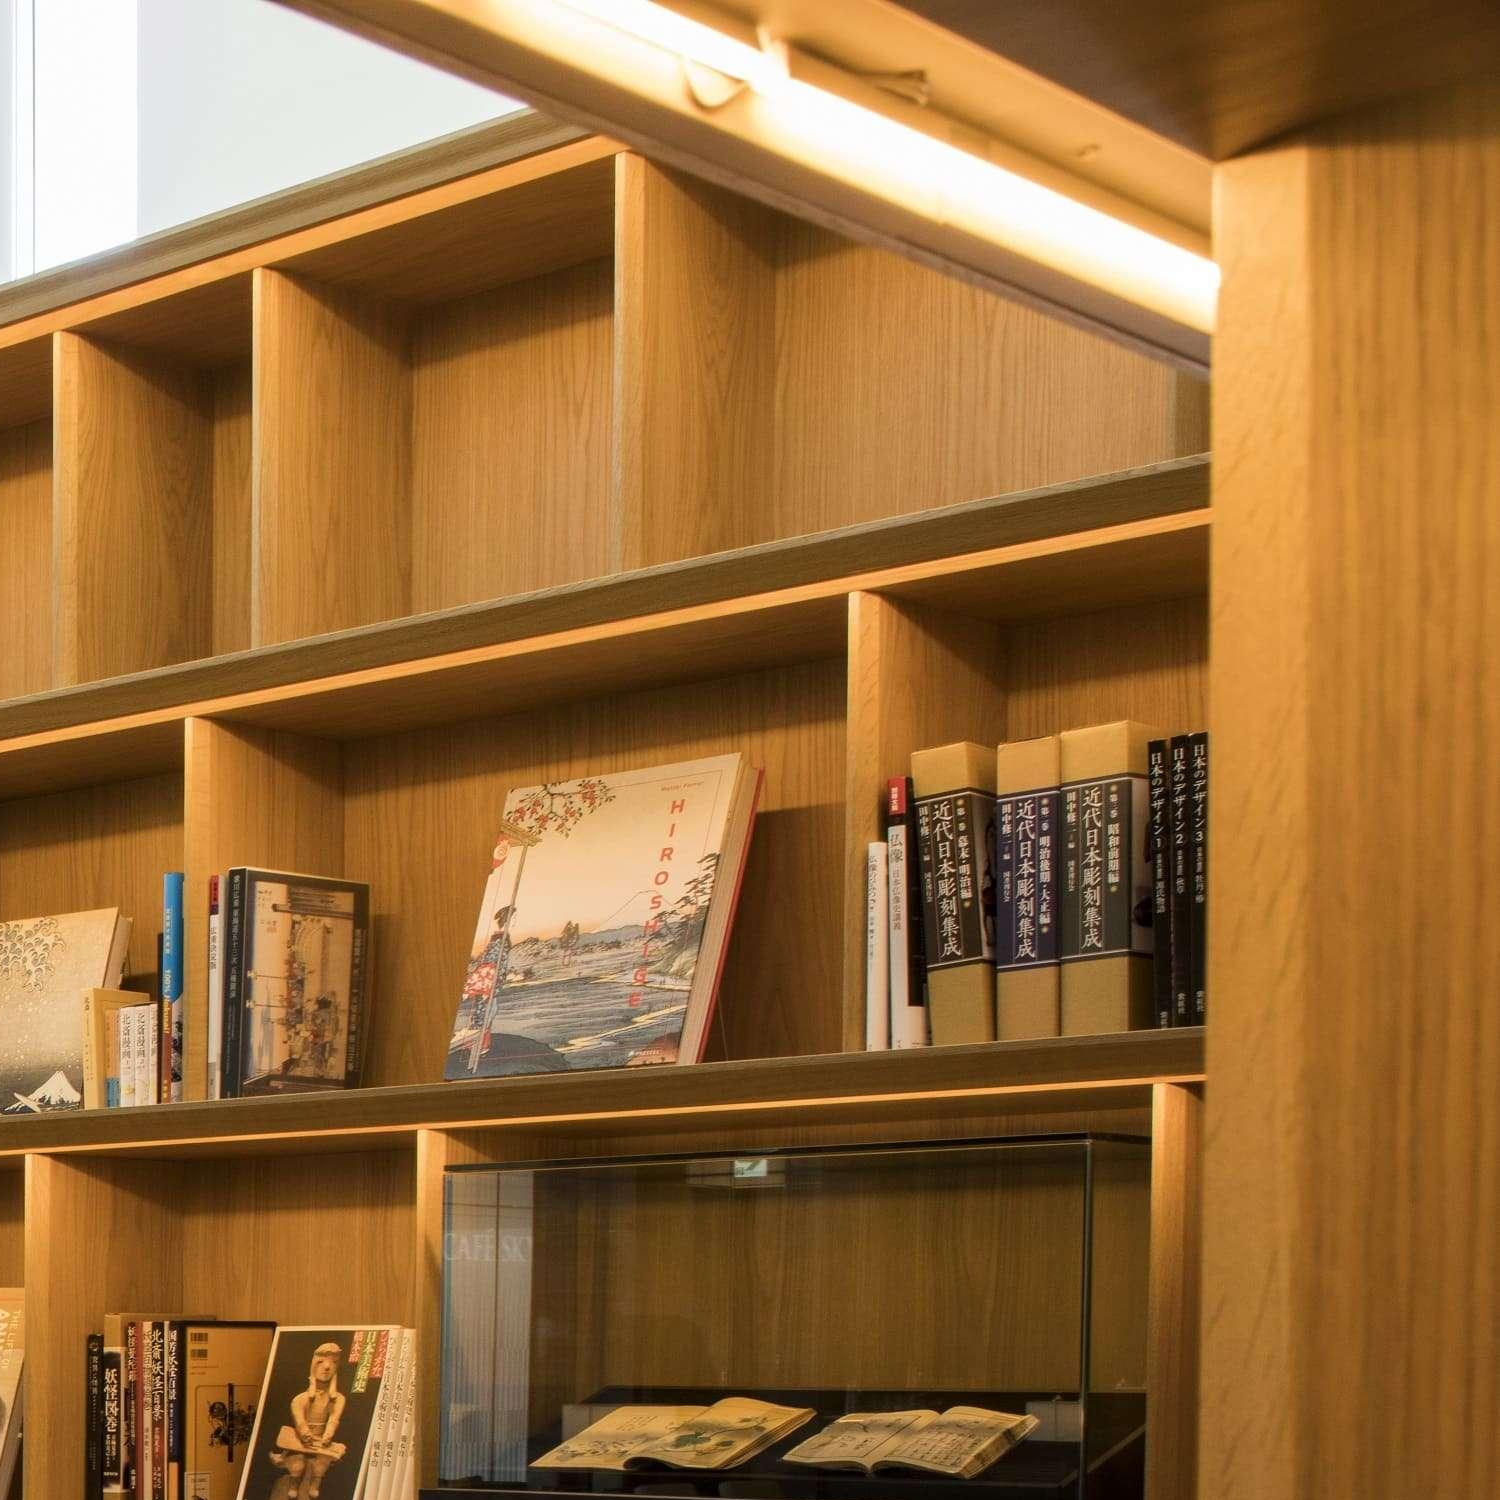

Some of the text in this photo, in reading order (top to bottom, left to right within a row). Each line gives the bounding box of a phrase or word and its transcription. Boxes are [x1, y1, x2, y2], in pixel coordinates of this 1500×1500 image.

[932, 800, 963, 958] 近代日本彫刻集成
[1016, 800, 1036, 959] 近代日本彫刻集成
[1081, 786, 1102, 949] 近代日本彫刻集成
